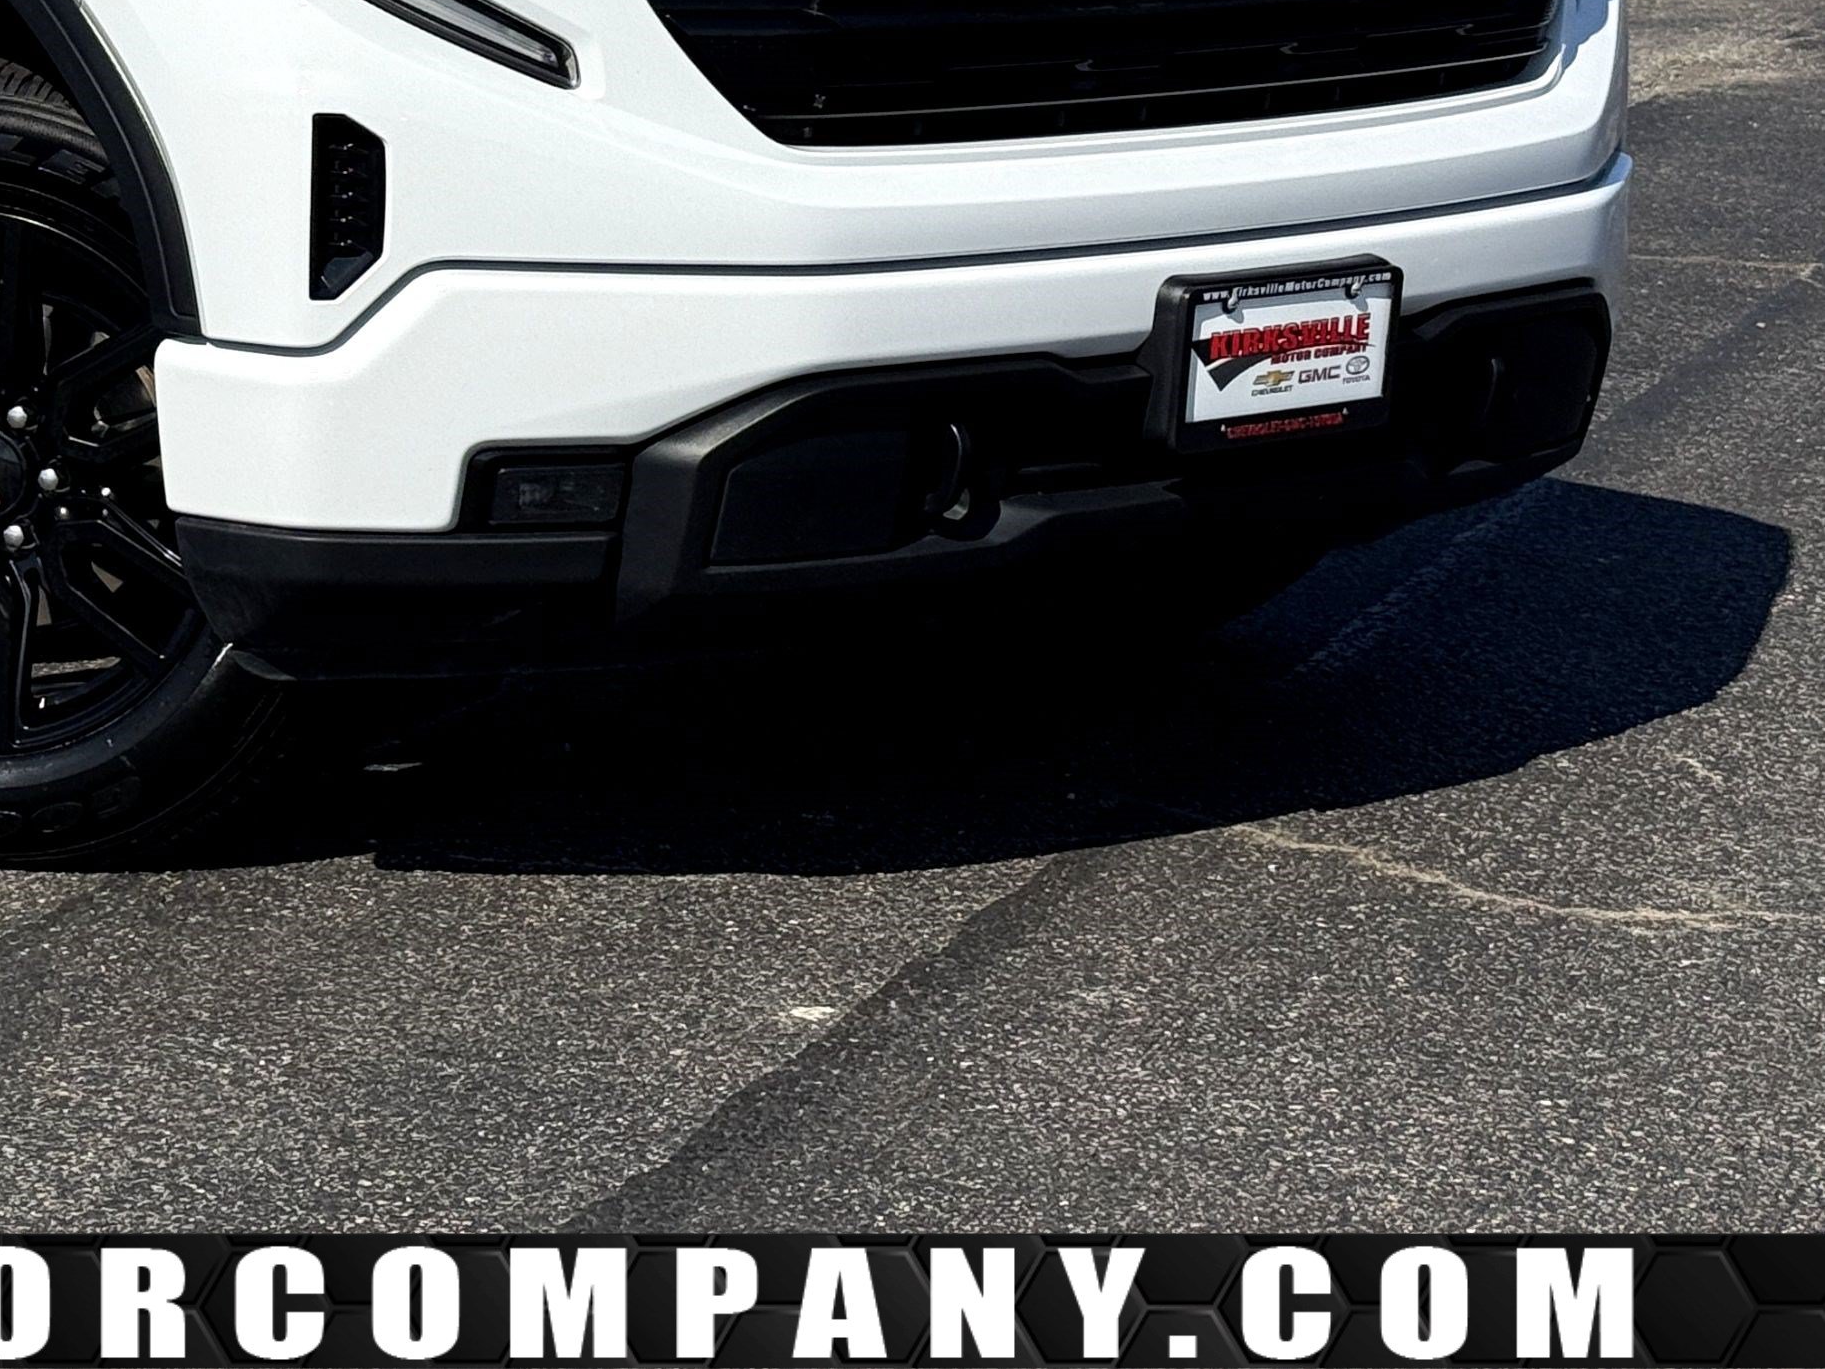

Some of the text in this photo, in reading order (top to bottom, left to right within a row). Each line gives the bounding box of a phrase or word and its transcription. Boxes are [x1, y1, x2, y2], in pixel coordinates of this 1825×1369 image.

[1210, 313, 1371, 360] KIRKSVILLE
[1270, 345, 1367, 365] MOTOR COMPANY
[1298, 365, 1342, 385] GMC
[1251, 385, 1293, 397] CHEVROLET
